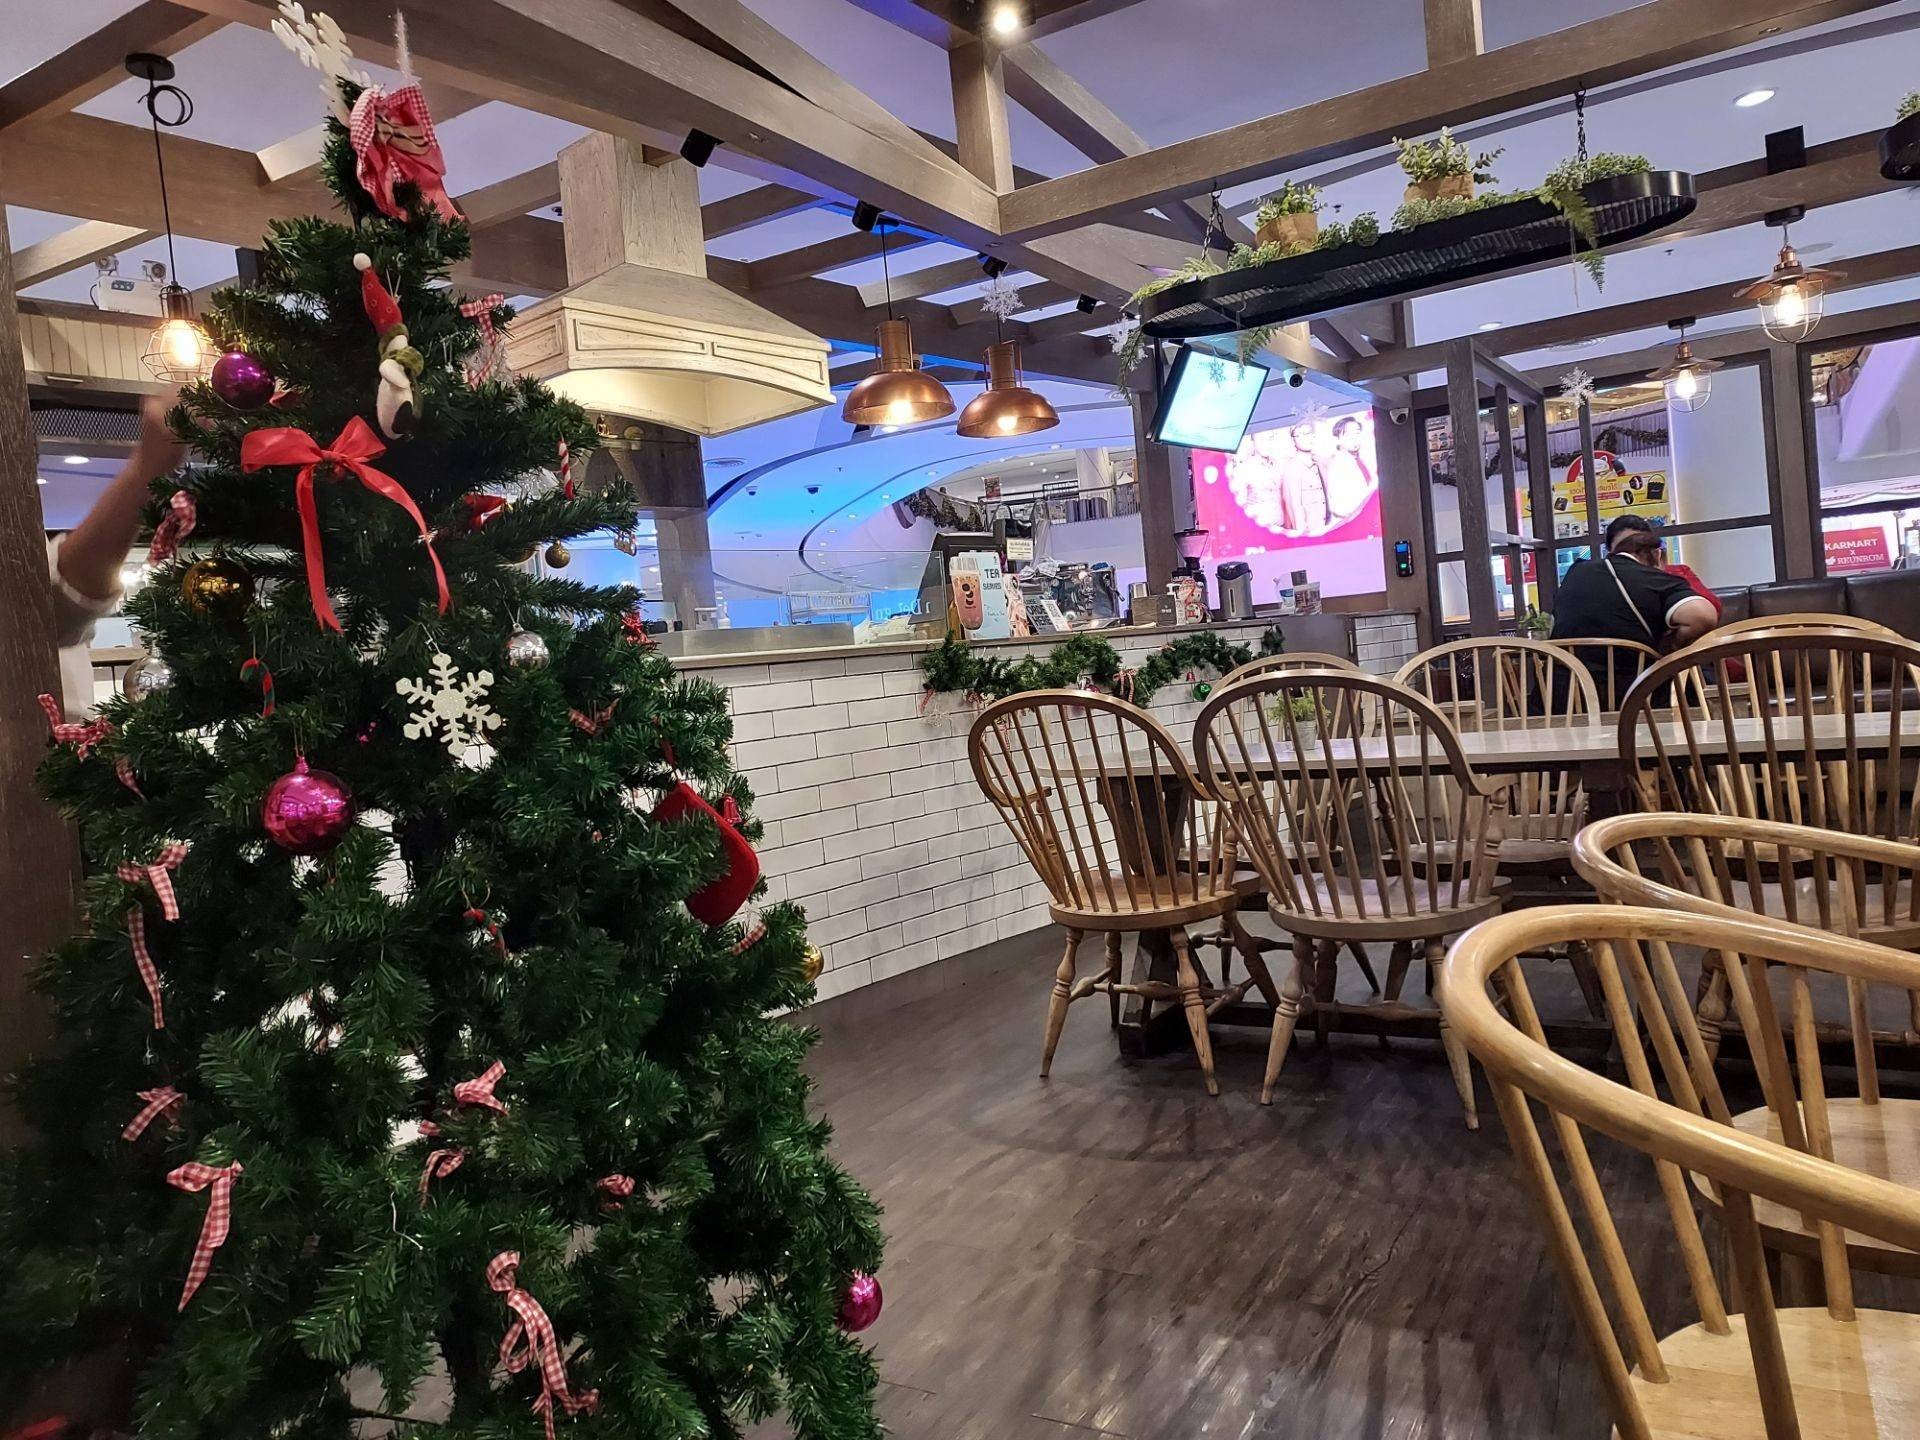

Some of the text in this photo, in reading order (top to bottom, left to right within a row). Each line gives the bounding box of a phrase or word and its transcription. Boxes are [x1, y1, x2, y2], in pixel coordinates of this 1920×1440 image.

[1824, 538, 1878, 551] KARMART
[984, 568, 1000, 579] TEA
[1026, 604, 1048, 615] ORDE
